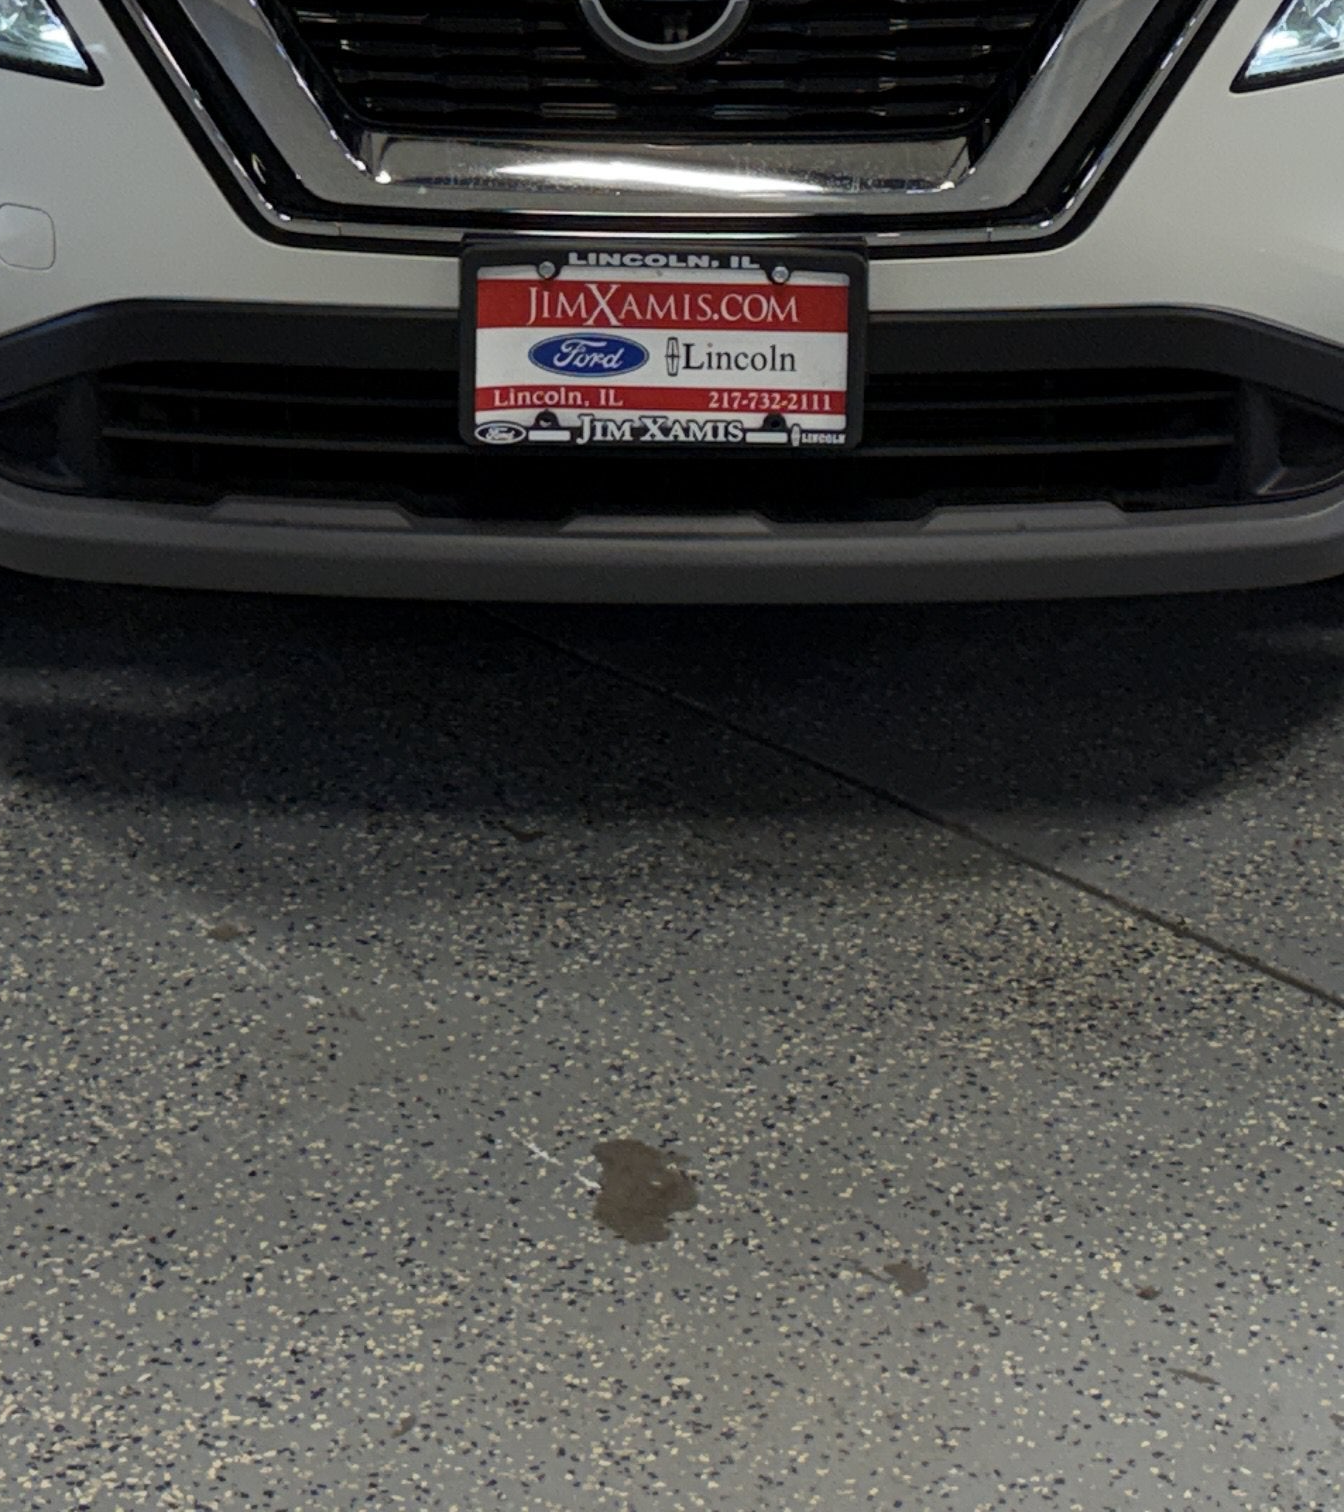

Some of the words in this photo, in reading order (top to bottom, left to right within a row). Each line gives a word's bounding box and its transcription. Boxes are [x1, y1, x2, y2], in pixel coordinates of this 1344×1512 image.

[730, 254, 760, 269] IL
[553, 338, 623, 370] Ford
[682, 342, 797, 373] Lincoln
[493, 388, 590, 408] Lincoln,
[599, 389, 624, 407] IL
[709, 391, 832, 410] 217-732-2111
[576, 415, 632, 443] JIM
[640, 416, 744, 442] XAMIS
[801, 432, 846, 444] LINCOLN
